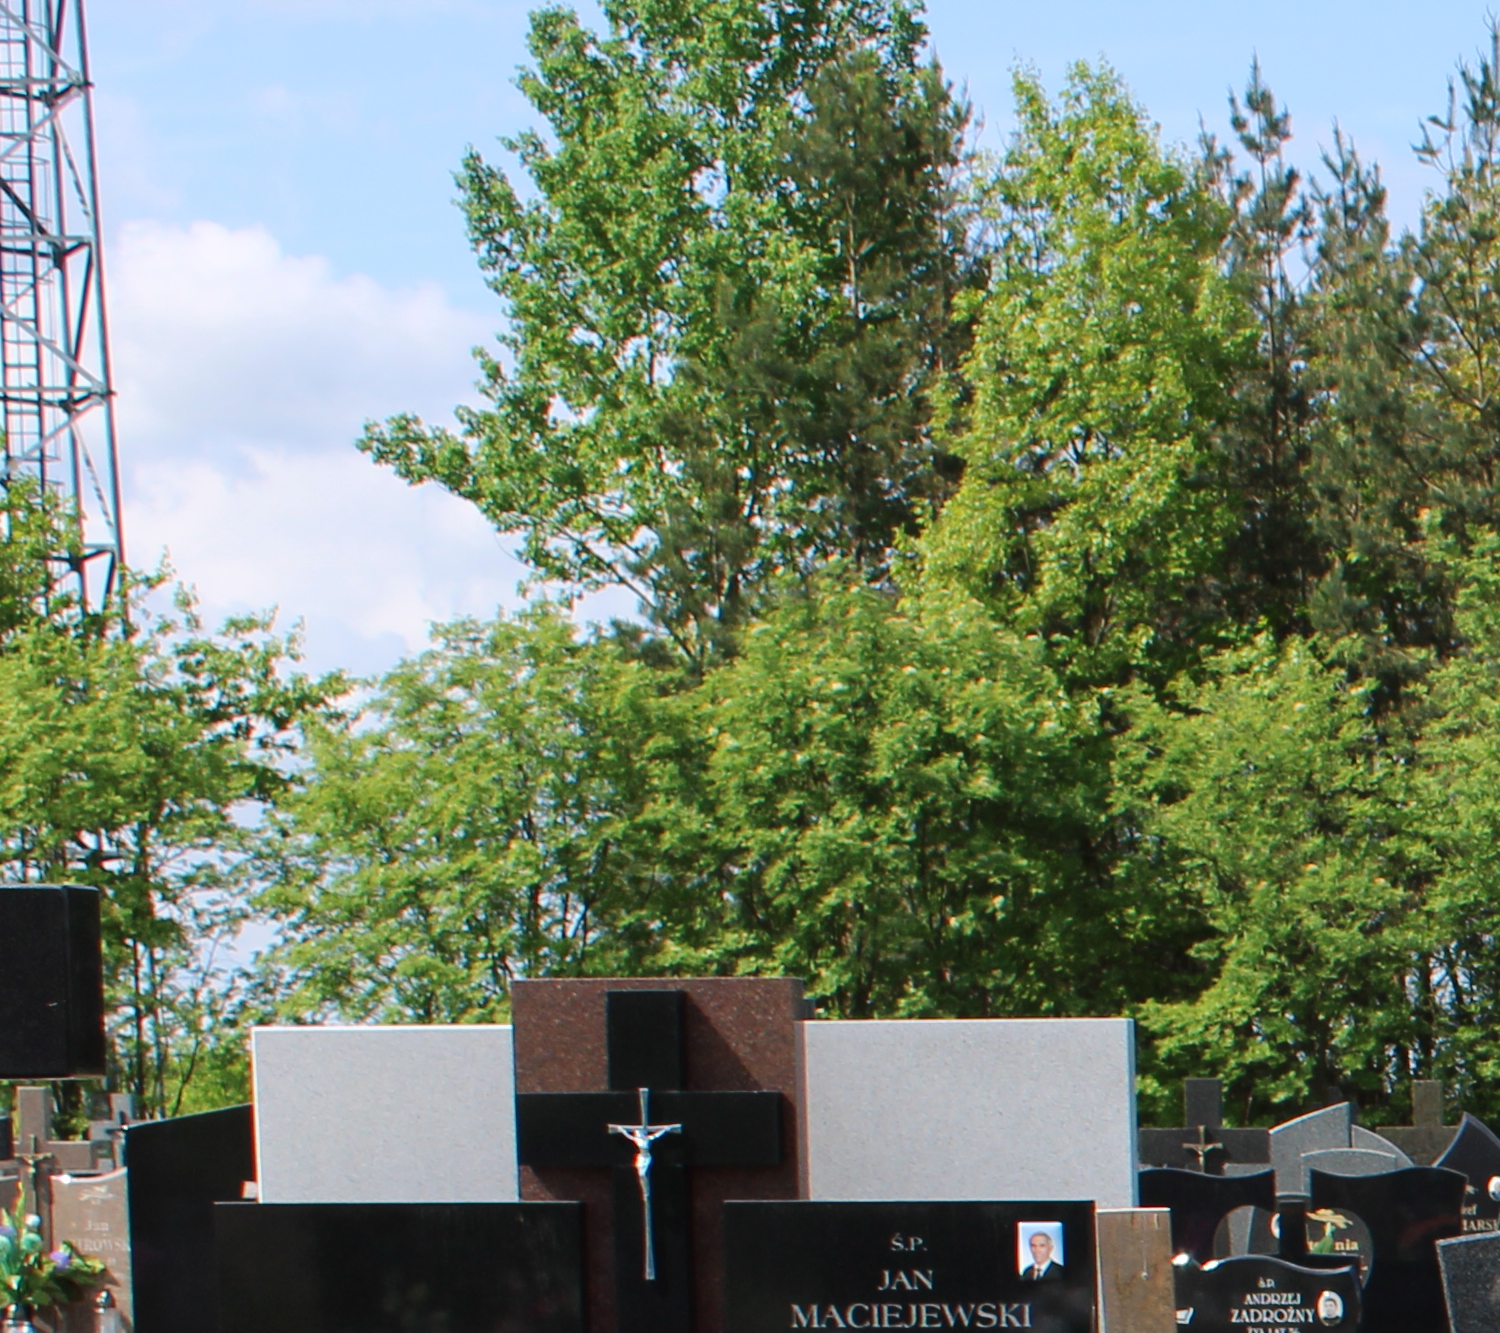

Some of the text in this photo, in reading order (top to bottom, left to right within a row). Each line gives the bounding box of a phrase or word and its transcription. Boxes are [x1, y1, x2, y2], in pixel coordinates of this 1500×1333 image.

[891, 1232, 927, 1251] Ś.P.
[878, 1269, 934, 1290] JAN
[1244, 1292, 1301, 1305] ANDRZEJ
[790, 1302, 1032, 1328] MACIEJEWSKI
[1230, 1306, 1315, 1323] ZADROŻNY
